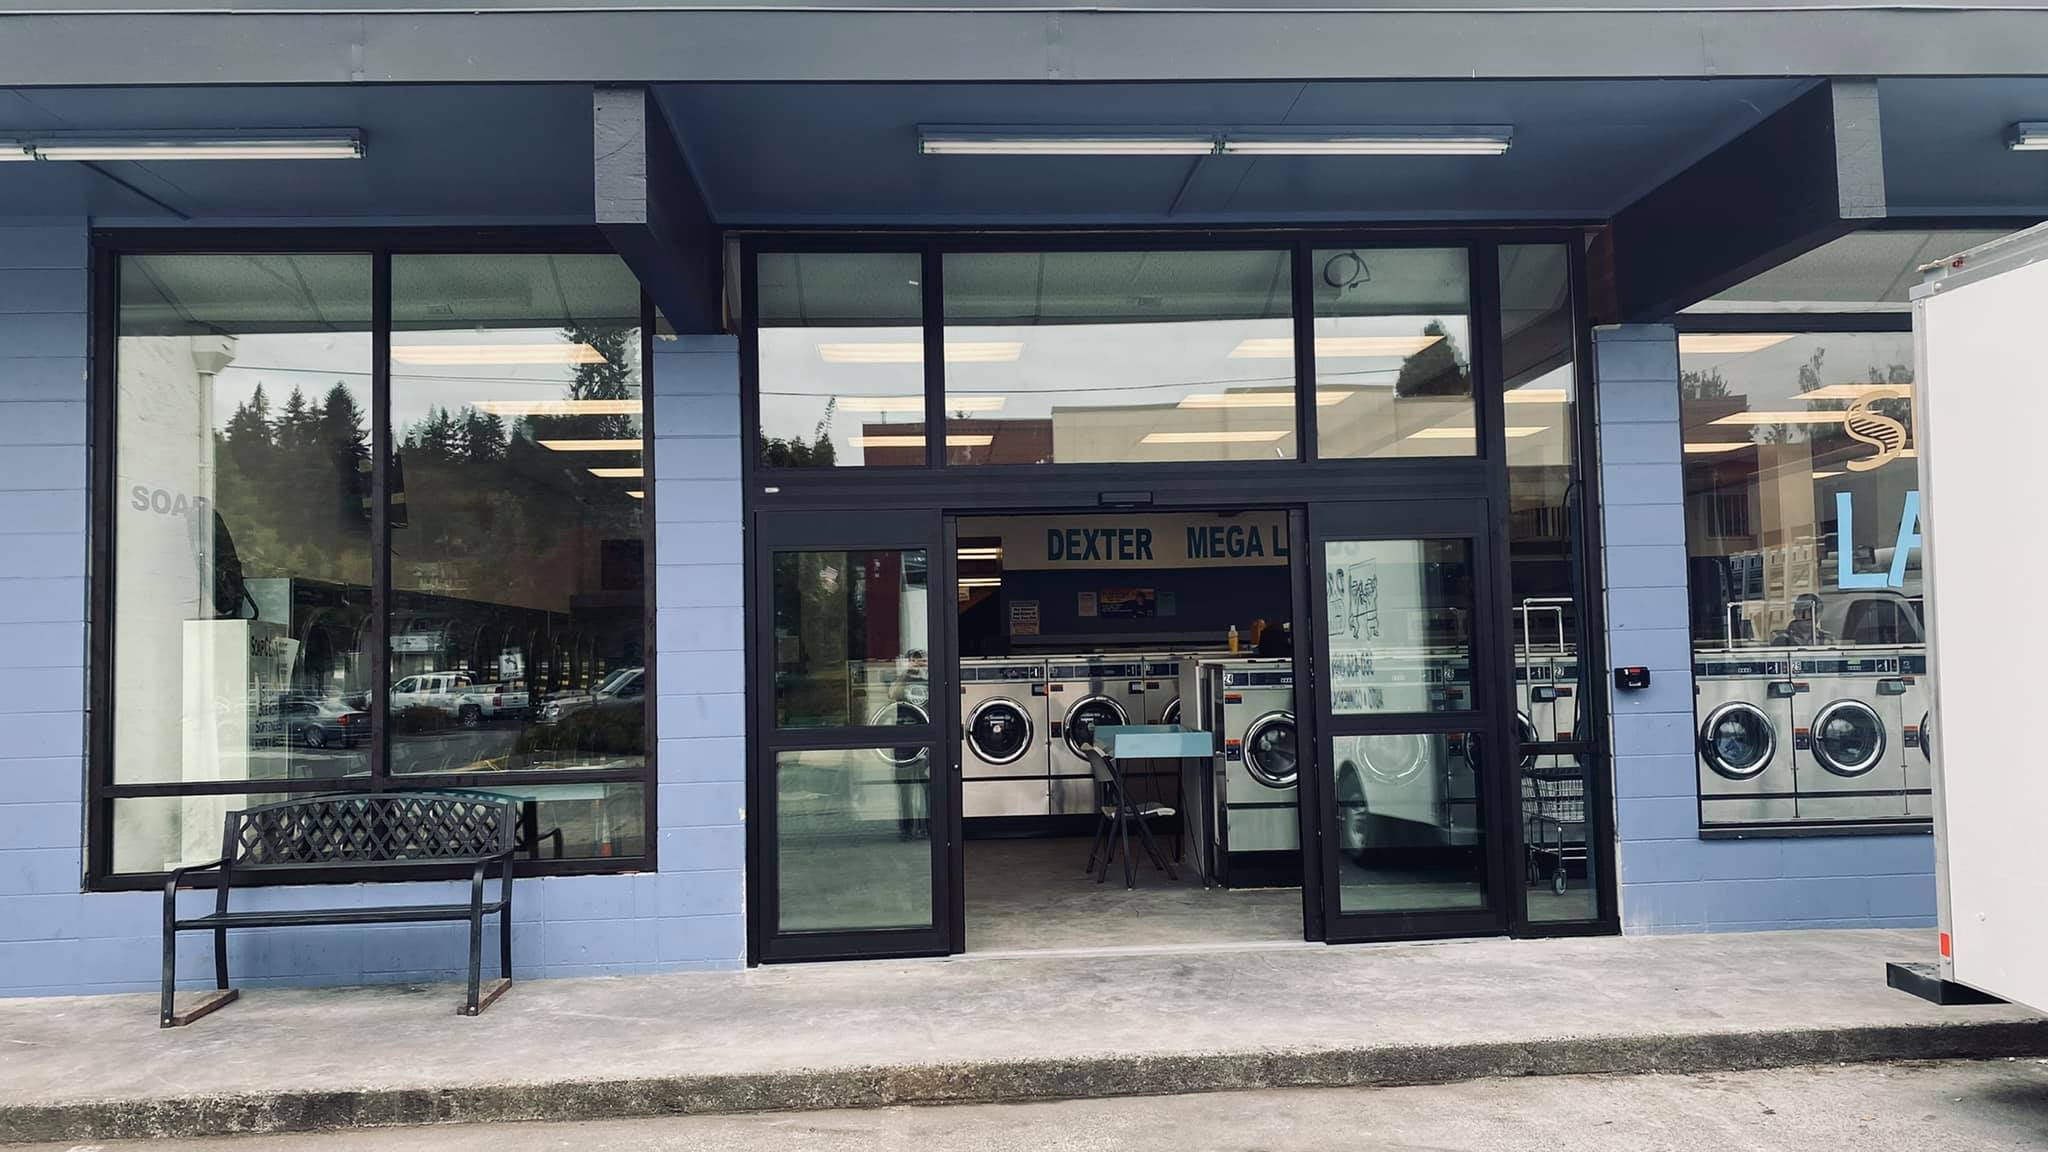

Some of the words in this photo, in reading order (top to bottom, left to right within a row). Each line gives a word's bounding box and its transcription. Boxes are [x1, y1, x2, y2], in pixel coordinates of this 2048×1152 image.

[1844, 389, 1917, 472] S
[1047, 528, 1153, 560] DEXTER
[1186, 525, 1264, 559] MEGA
[1836, 491, 1920, 588] LA
